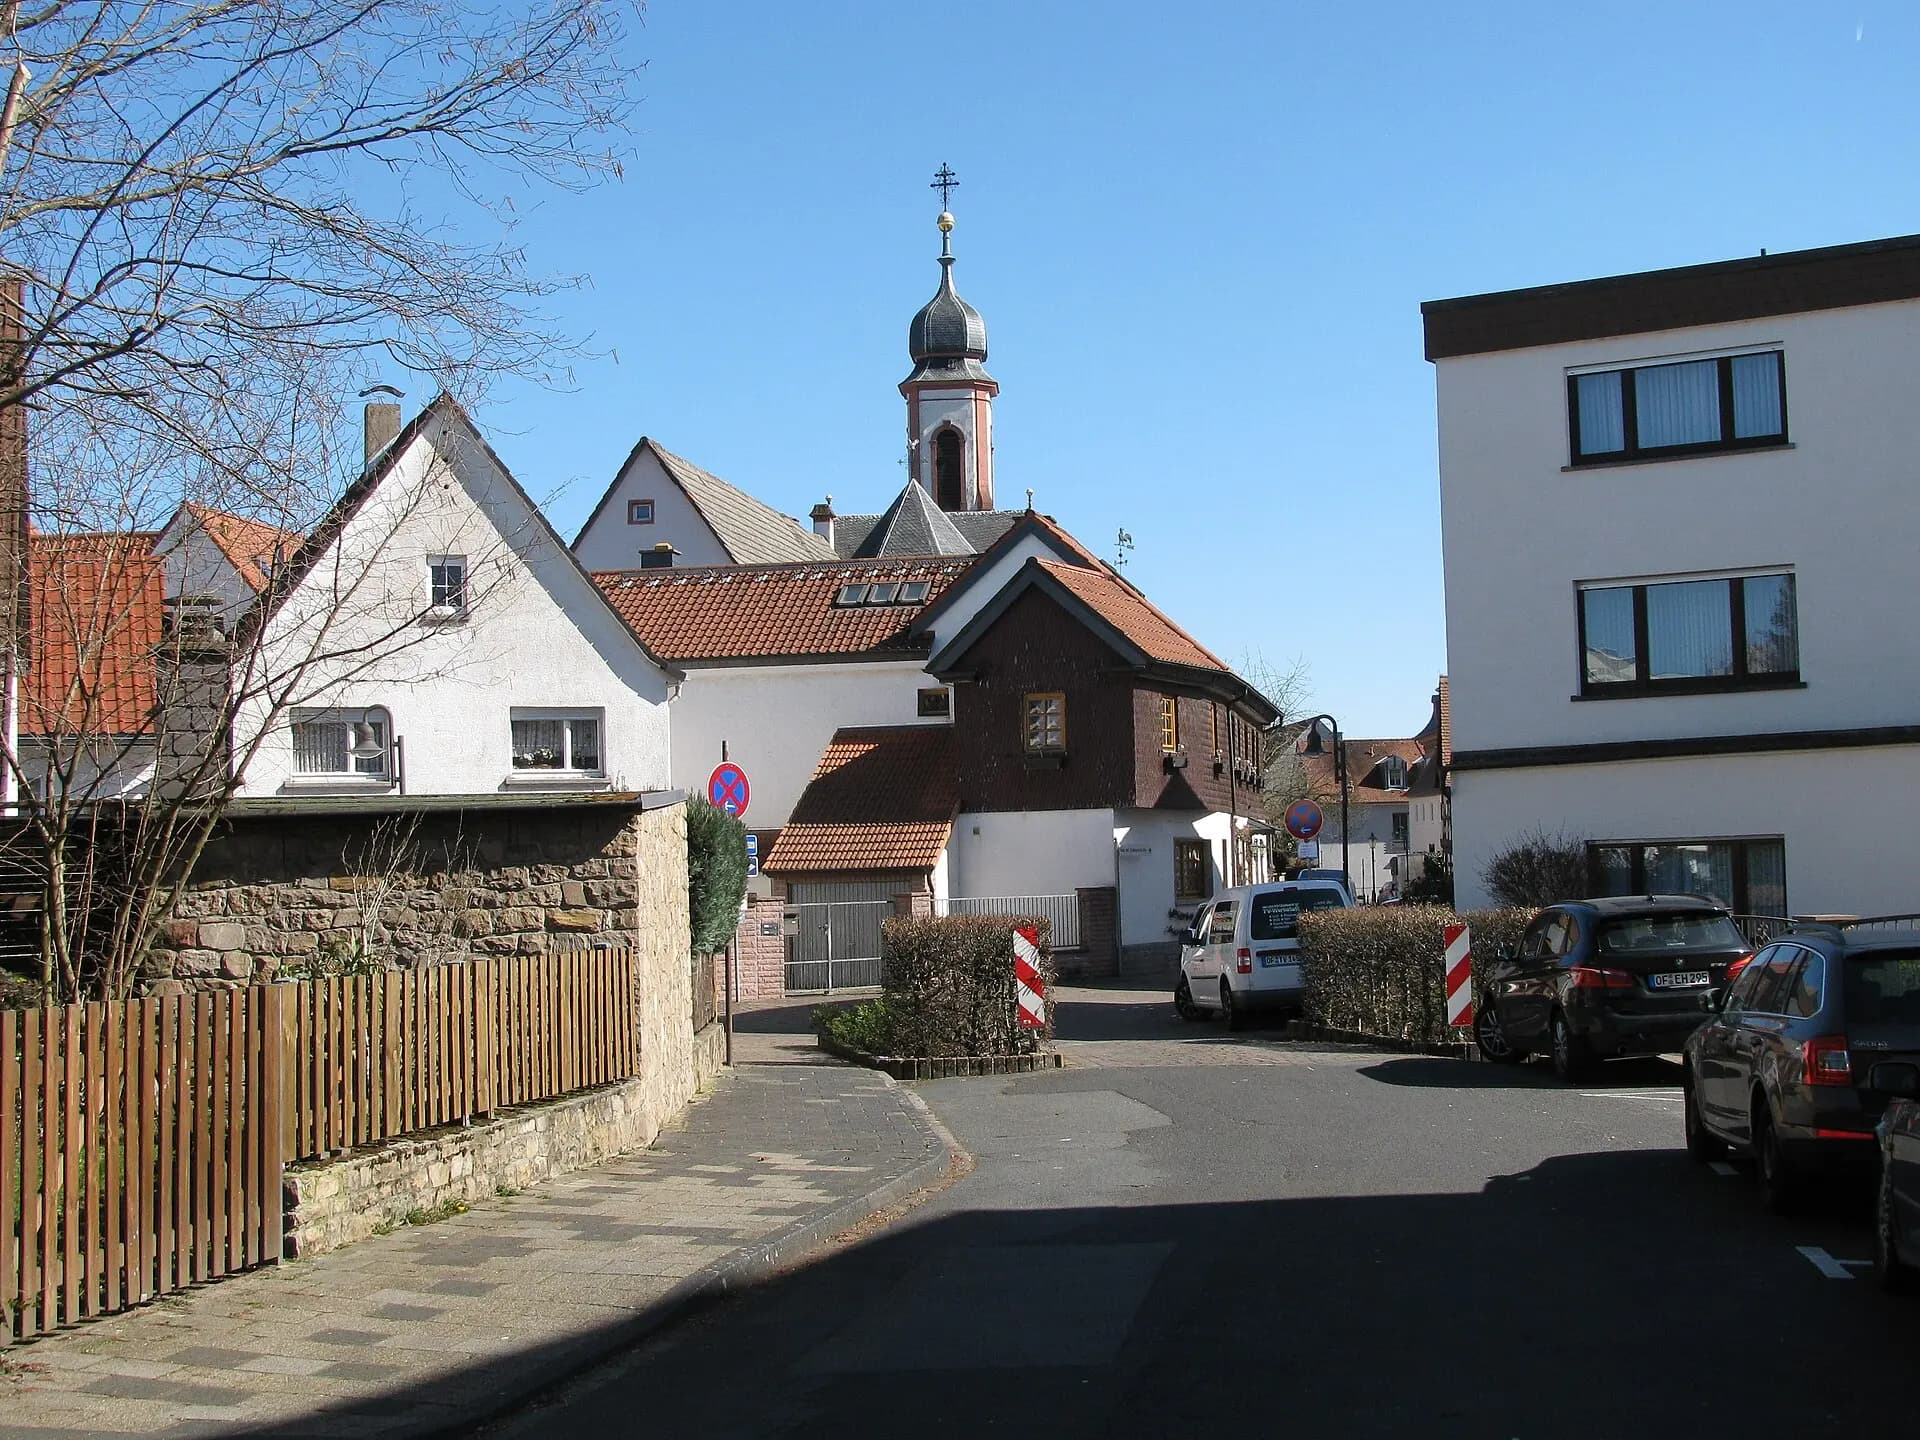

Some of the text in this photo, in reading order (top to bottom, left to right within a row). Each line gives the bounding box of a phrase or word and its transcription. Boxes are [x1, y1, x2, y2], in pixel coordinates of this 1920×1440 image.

[1655, 972, 1708, 985] OF EH 295
